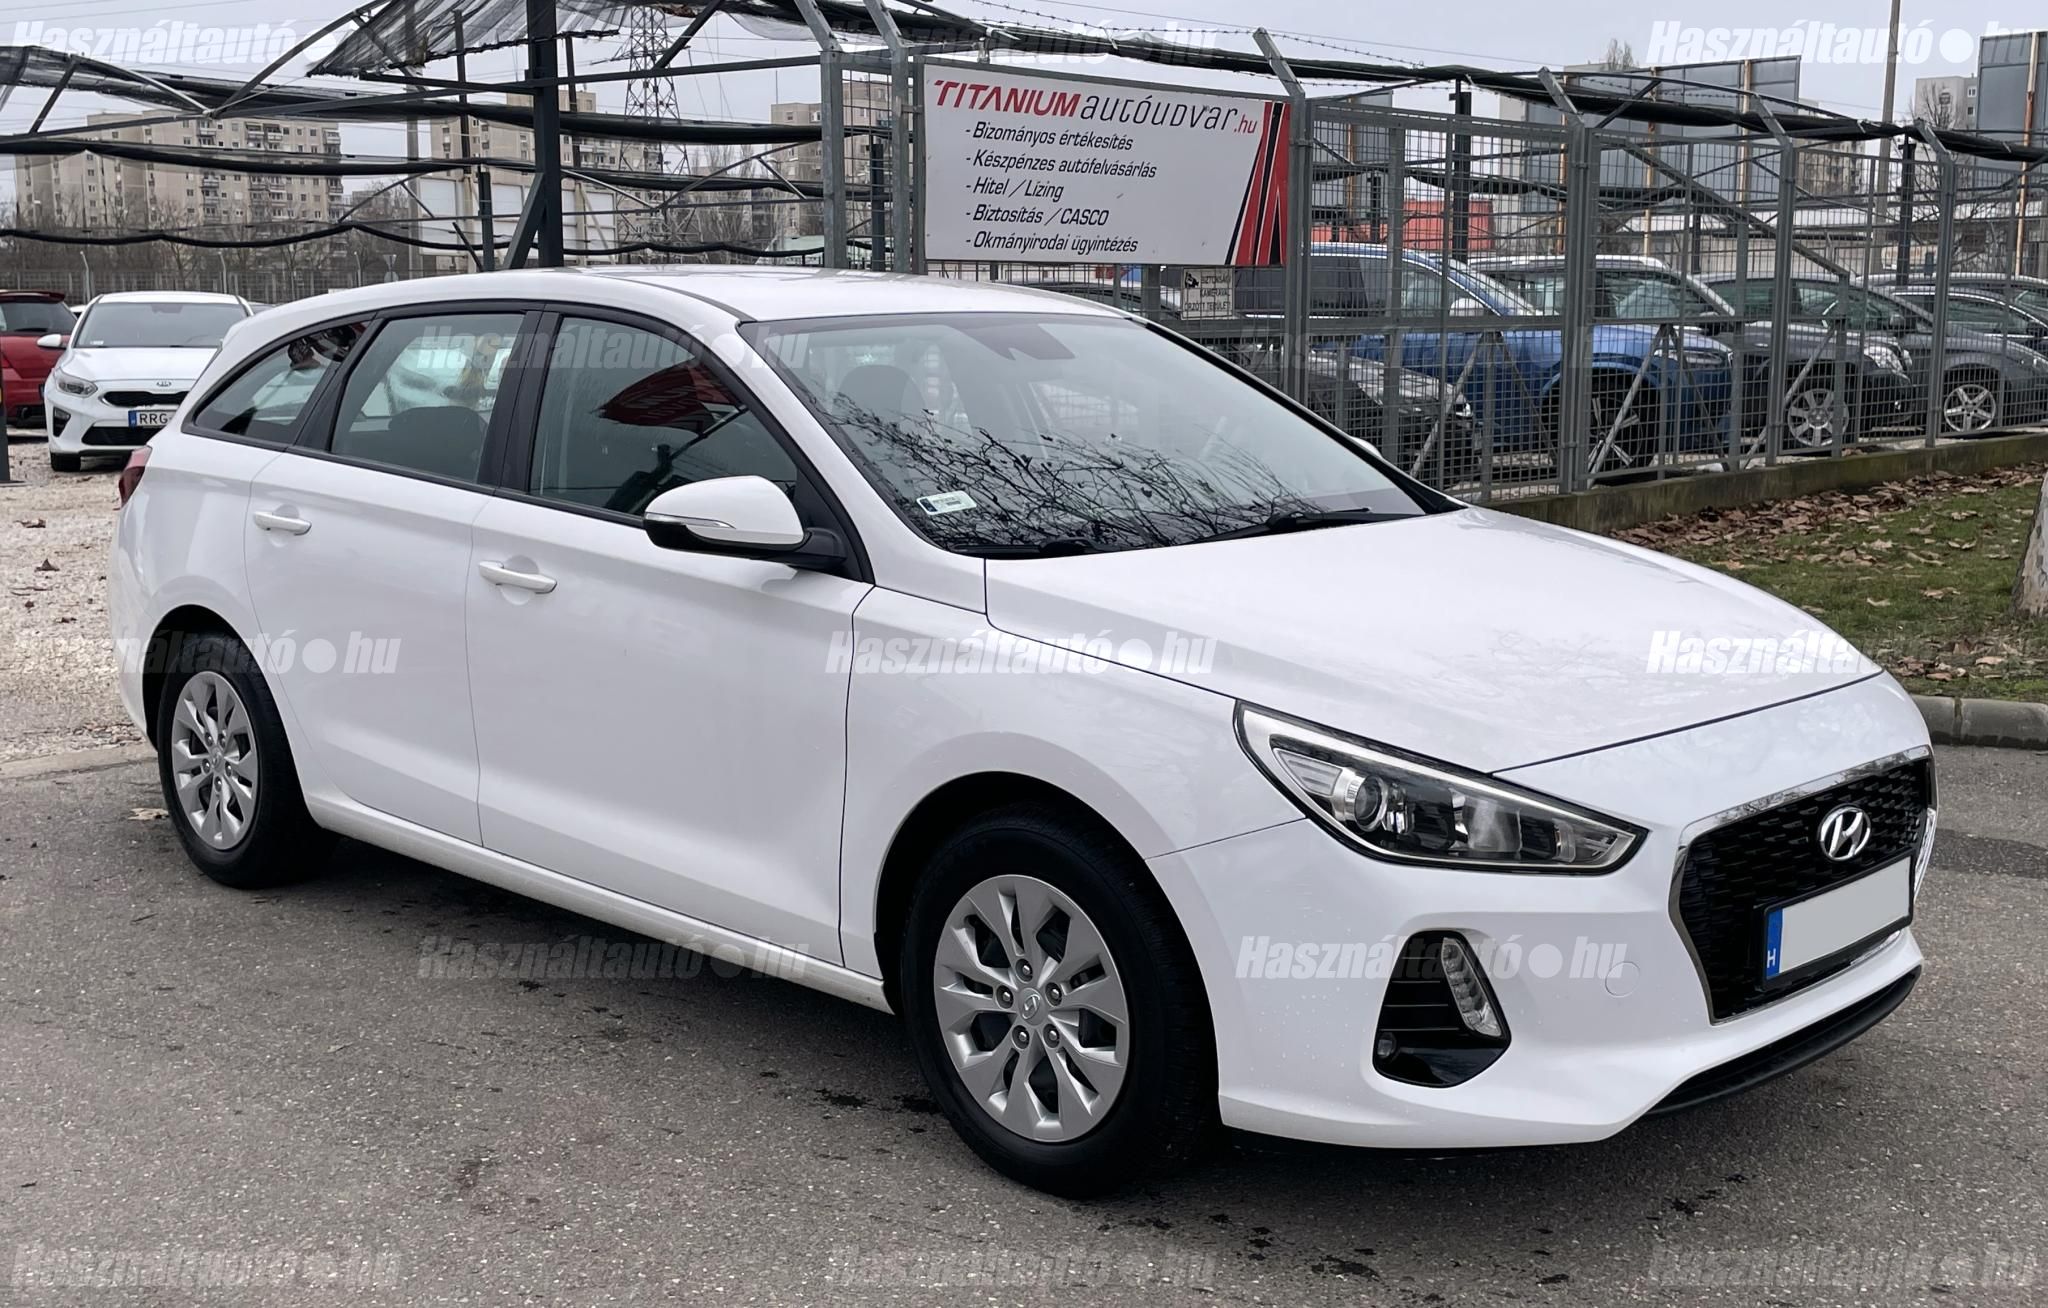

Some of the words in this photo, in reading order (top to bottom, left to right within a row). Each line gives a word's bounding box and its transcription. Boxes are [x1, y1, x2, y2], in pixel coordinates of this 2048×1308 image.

[934, 80, 1081, 117] TITANIUM
[973, 121, 1056, 147] Bizományos
[1059, 129, 1133, 151] értékesítés
[973, 149, 1056, 173] Készpénzes
[1059, 158, 1157, 178] autófelvásárlás
[973, 177, 1010, 195] Hitel
[1024, 180, 1064, 202] Lízing
[973, 204, 1044, 224] Biztosítás
[1060, 208, 1109, 226] CASCO
[973, 231, 1070, 254] Okmányirodai
[1071, 235, 1139, 255] ügyintézés
[1767, 948, 1776, 969] H
